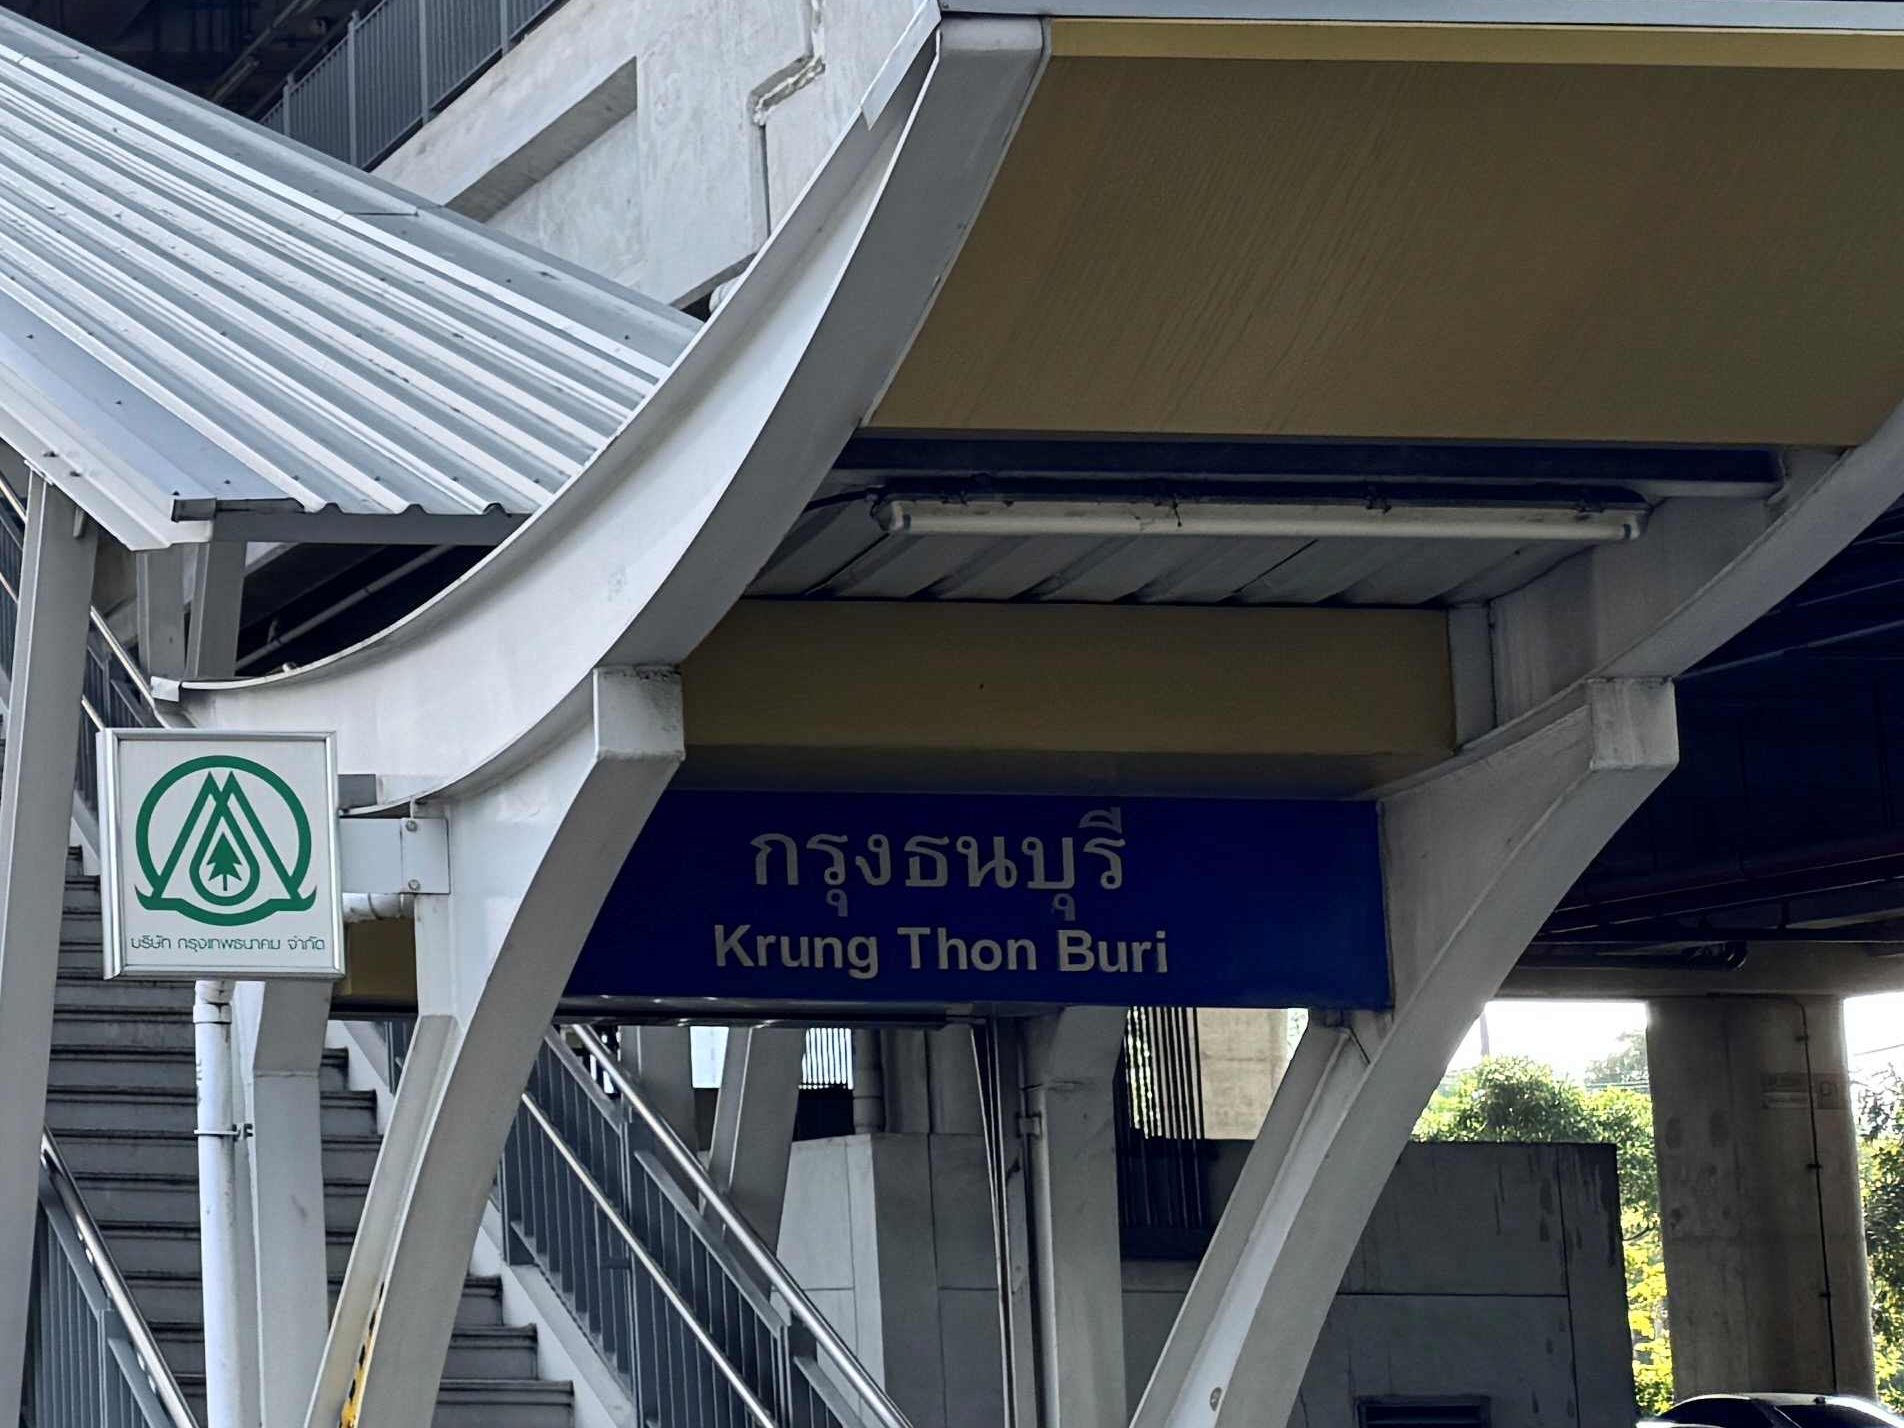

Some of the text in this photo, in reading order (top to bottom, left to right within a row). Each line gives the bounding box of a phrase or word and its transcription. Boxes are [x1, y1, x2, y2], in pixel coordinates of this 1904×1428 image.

[750, 806, 1126, 921] กรุงธนบุรี
[131, 934, 325, 953] บริษัท กรุงเทพธนาคม จำกัด
[713, 924, 1168, 980] Krung Thon Buri
